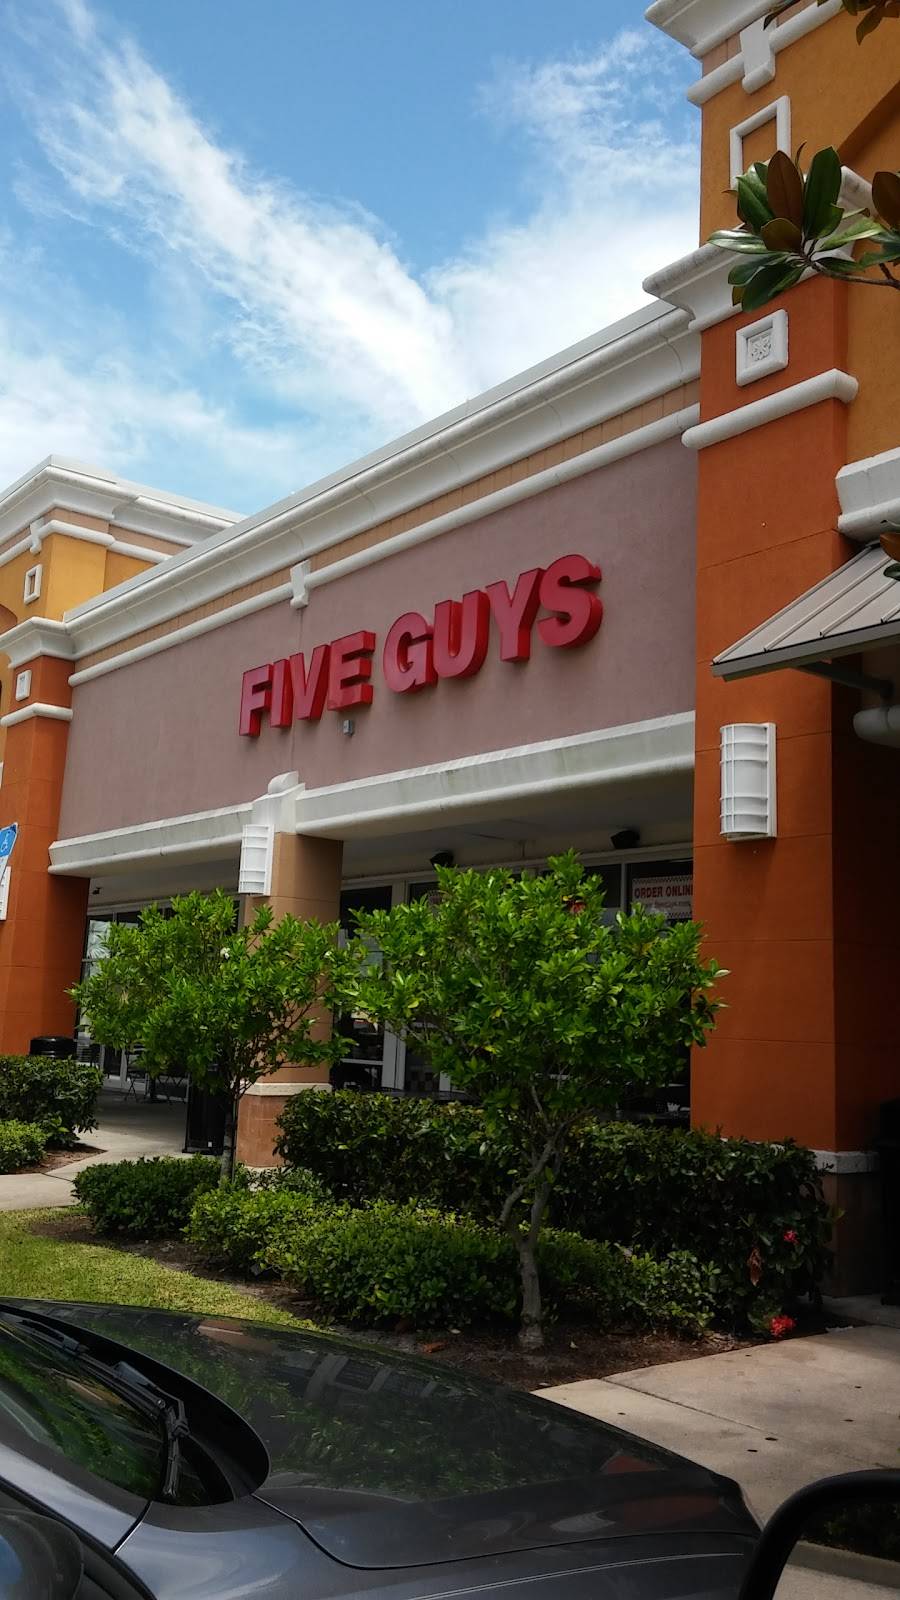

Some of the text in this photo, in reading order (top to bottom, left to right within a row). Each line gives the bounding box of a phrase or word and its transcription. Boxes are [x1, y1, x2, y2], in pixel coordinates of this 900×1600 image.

[239, 554, 603, 737] FIVE GUYS
[634, 887, 663, 898] ORDER
